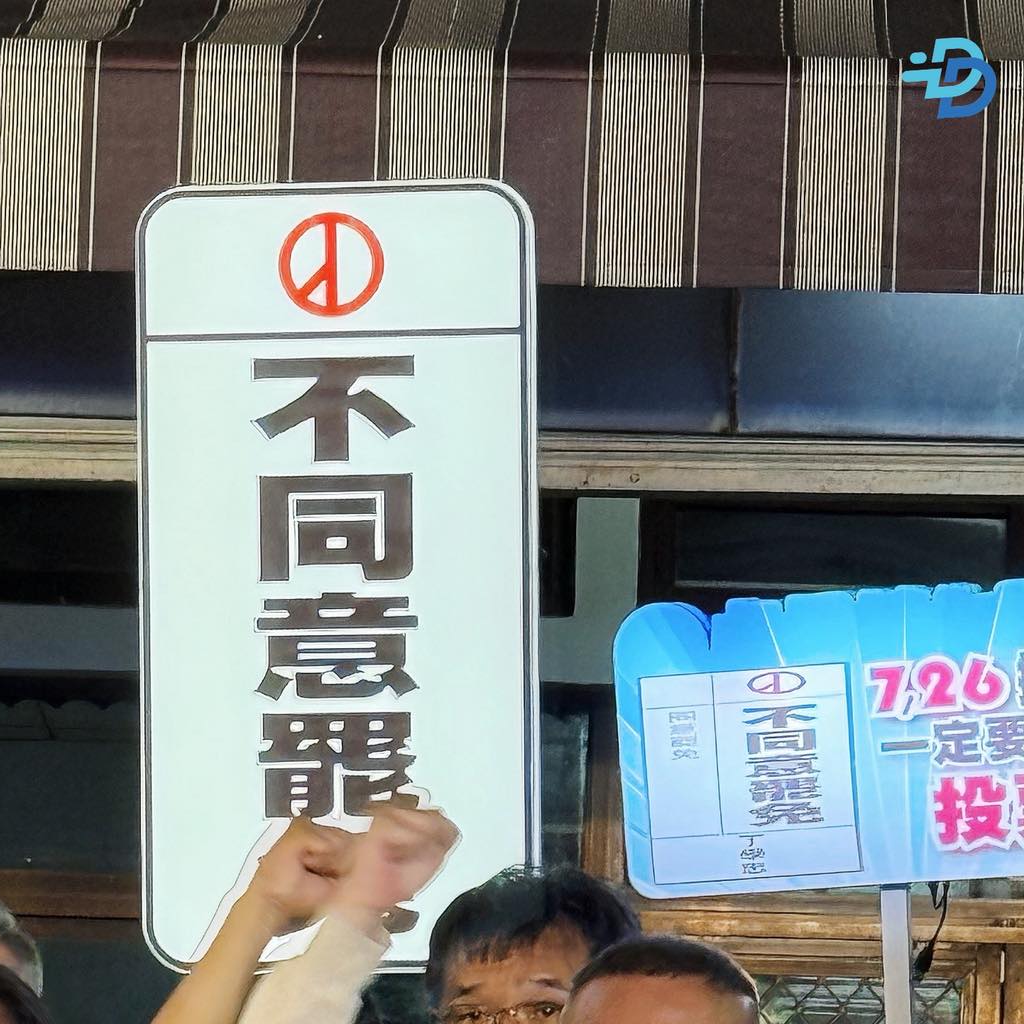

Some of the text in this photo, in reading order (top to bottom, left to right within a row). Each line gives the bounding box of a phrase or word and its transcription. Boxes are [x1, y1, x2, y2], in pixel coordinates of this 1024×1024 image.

[250, 354, 420, 932] 不同意罷
[933, 773, 1024, 845] 投
